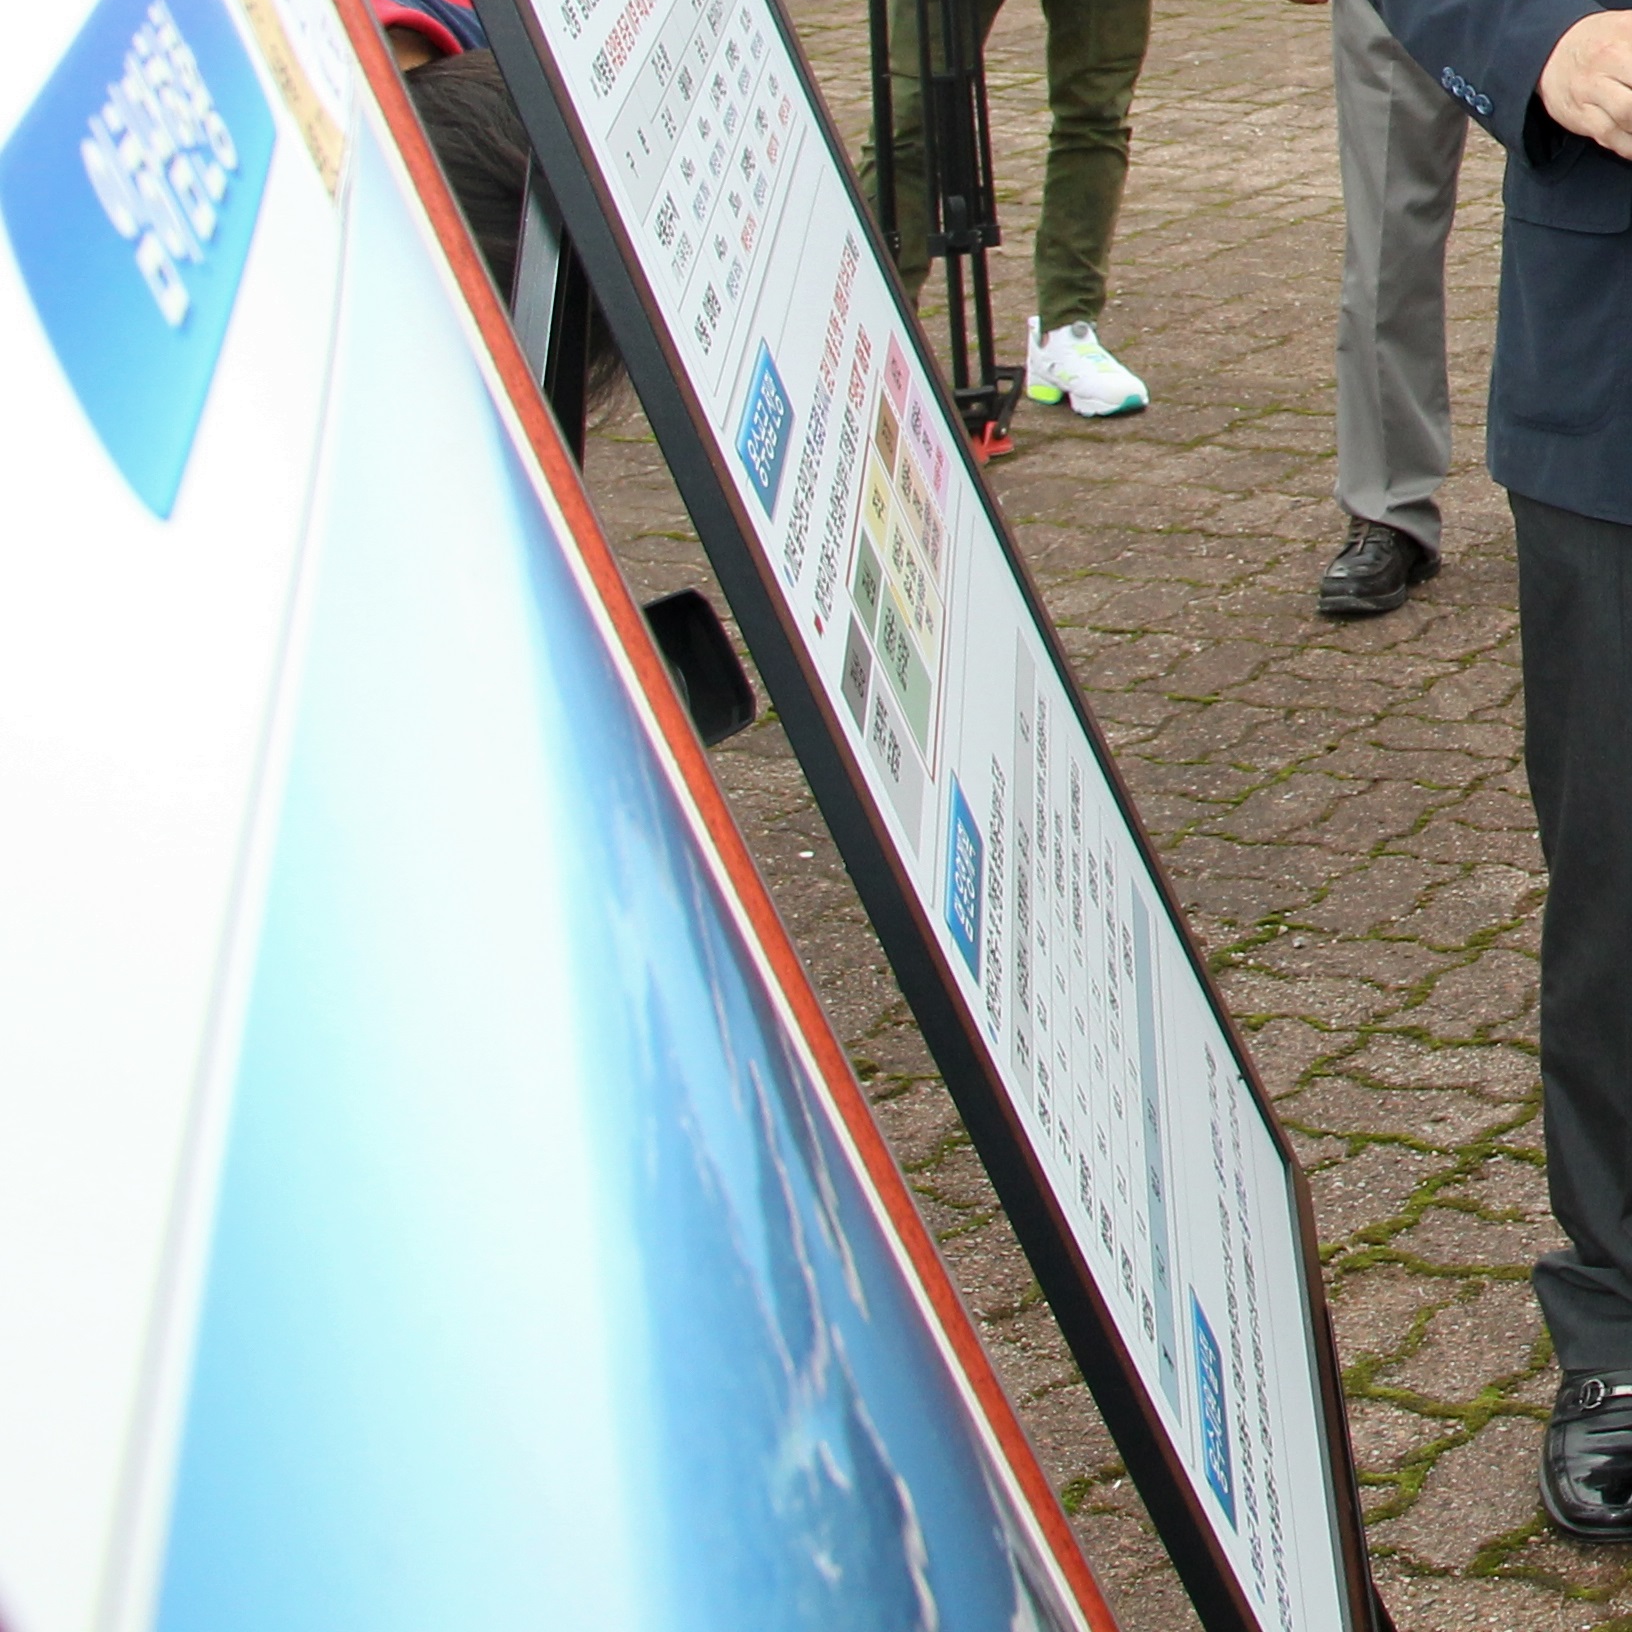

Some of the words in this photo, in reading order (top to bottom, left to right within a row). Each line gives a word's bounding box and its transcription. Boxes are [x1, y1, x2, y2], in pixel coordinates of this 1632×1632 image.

[747, 398, 778, 488] 용수공급
[761, 370, 785, 427] 전망
[954, 817, 976, 916] 운영계획
[1198, 1325, 1220, 1391] 실적
[1202, 1379, 1229, 1494] 용수지원
